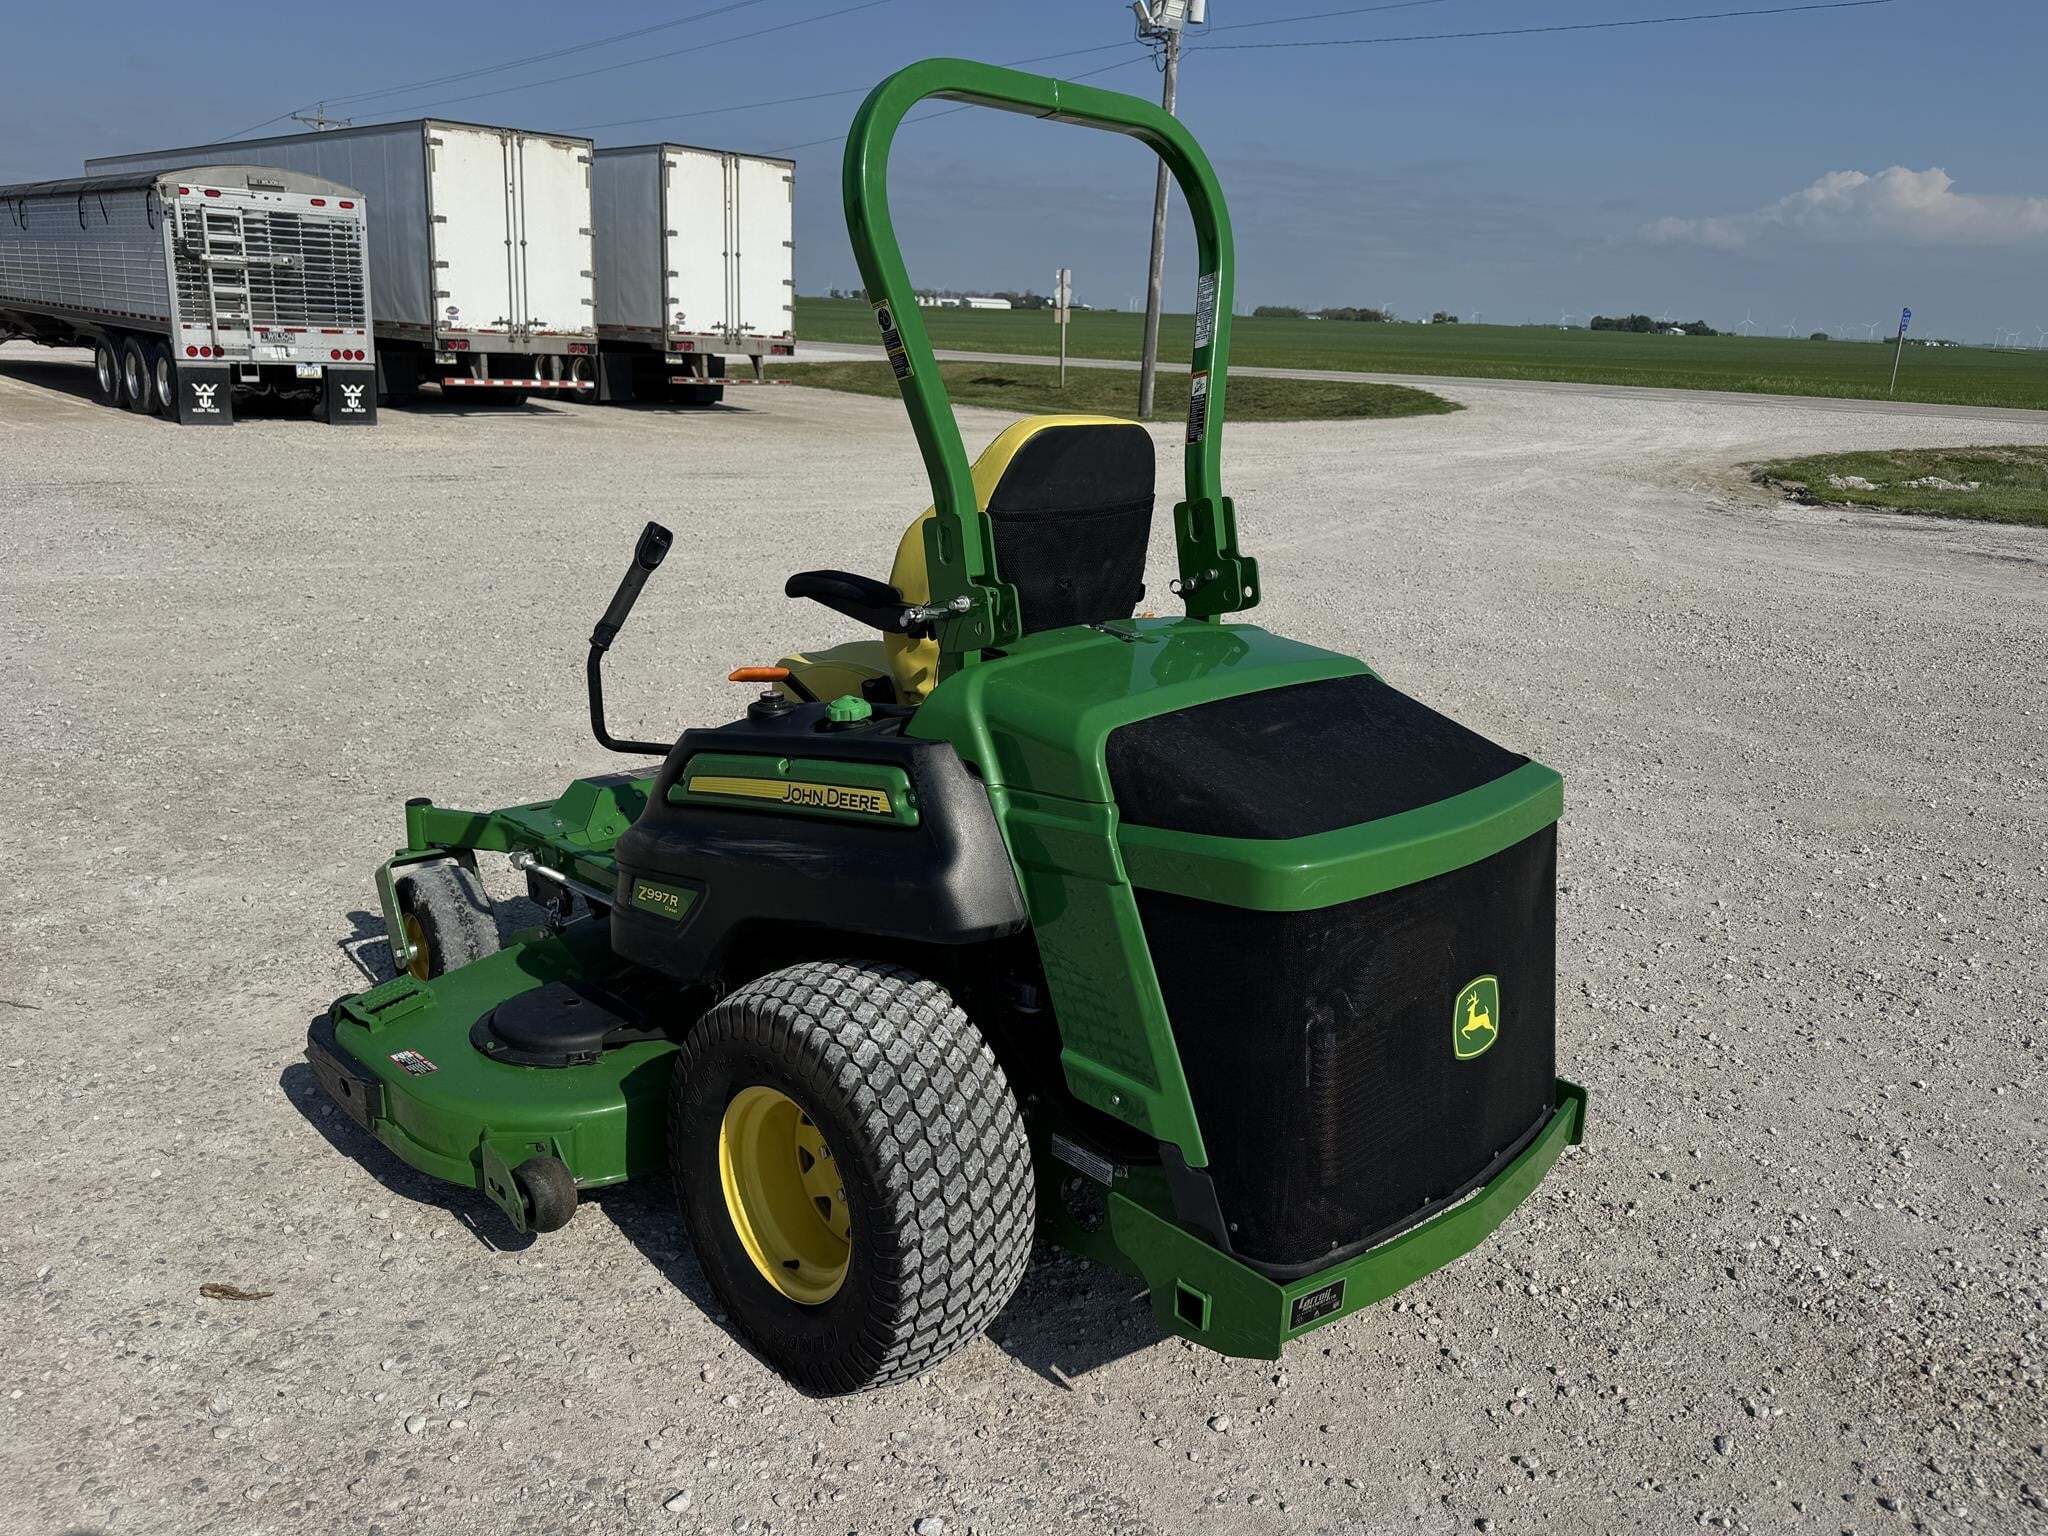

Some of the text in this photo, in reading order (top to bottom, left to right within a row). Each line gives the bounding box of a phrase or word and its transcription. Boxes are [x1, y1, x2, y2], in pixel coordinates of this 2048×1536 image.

[782, 784, 881, 811] JOHN DEERE
[638, 885, 679, 906] Z997R
